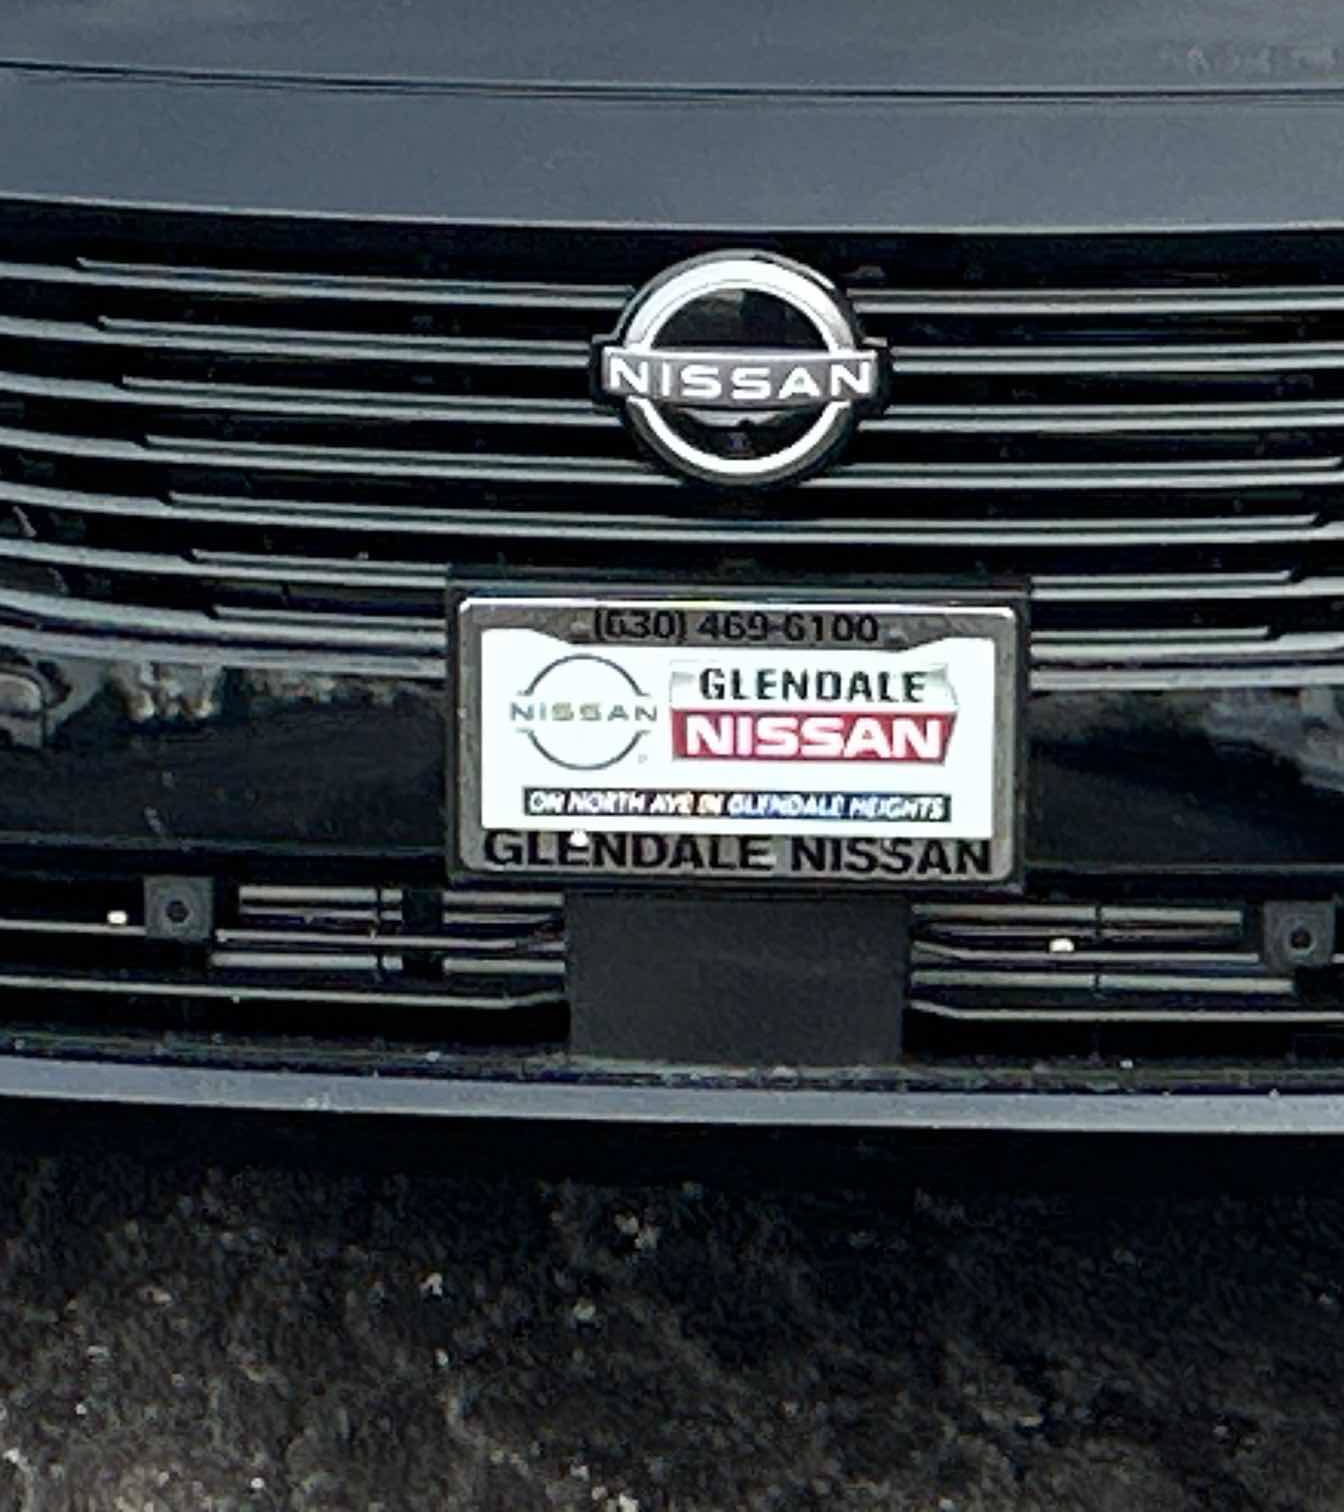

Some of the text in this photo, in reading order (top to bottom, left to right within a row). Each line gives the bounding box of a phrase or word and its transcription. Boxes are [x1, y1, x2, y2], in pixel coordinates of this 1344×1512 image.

[609, 358, 873, 400] NISSAN
[594, 608, 879, 645] (630) 469-6100
[699, 668, 927, 703] GLENDALE
[510, 702, 658, 722] NISSAN
[686, 714, 943, 759] NISSAN
[567, 791, 646, 814] NORTH
[483, 830, 992, 875] GLENDALE NISSAN
